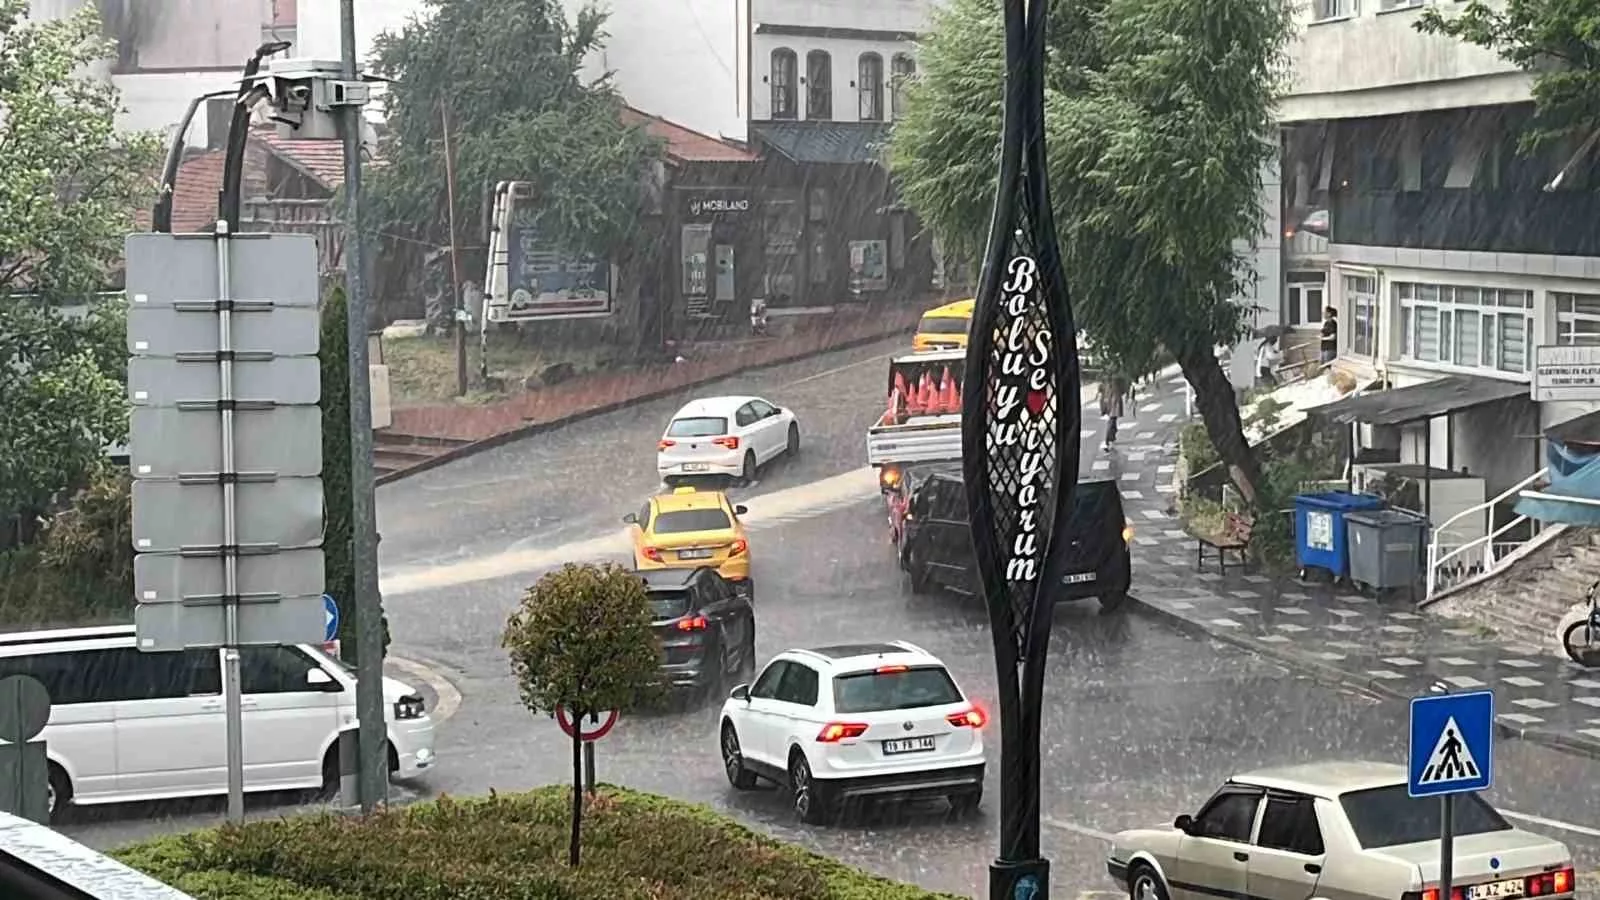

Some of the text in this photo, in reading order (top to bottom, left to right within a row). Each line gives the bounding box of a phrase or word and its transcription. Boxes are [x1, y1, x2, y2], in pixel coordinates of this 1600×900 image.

[995, 256, 1036, 446] Boluyu
[1470, 880, 1524, 899] 14 AZ 424
